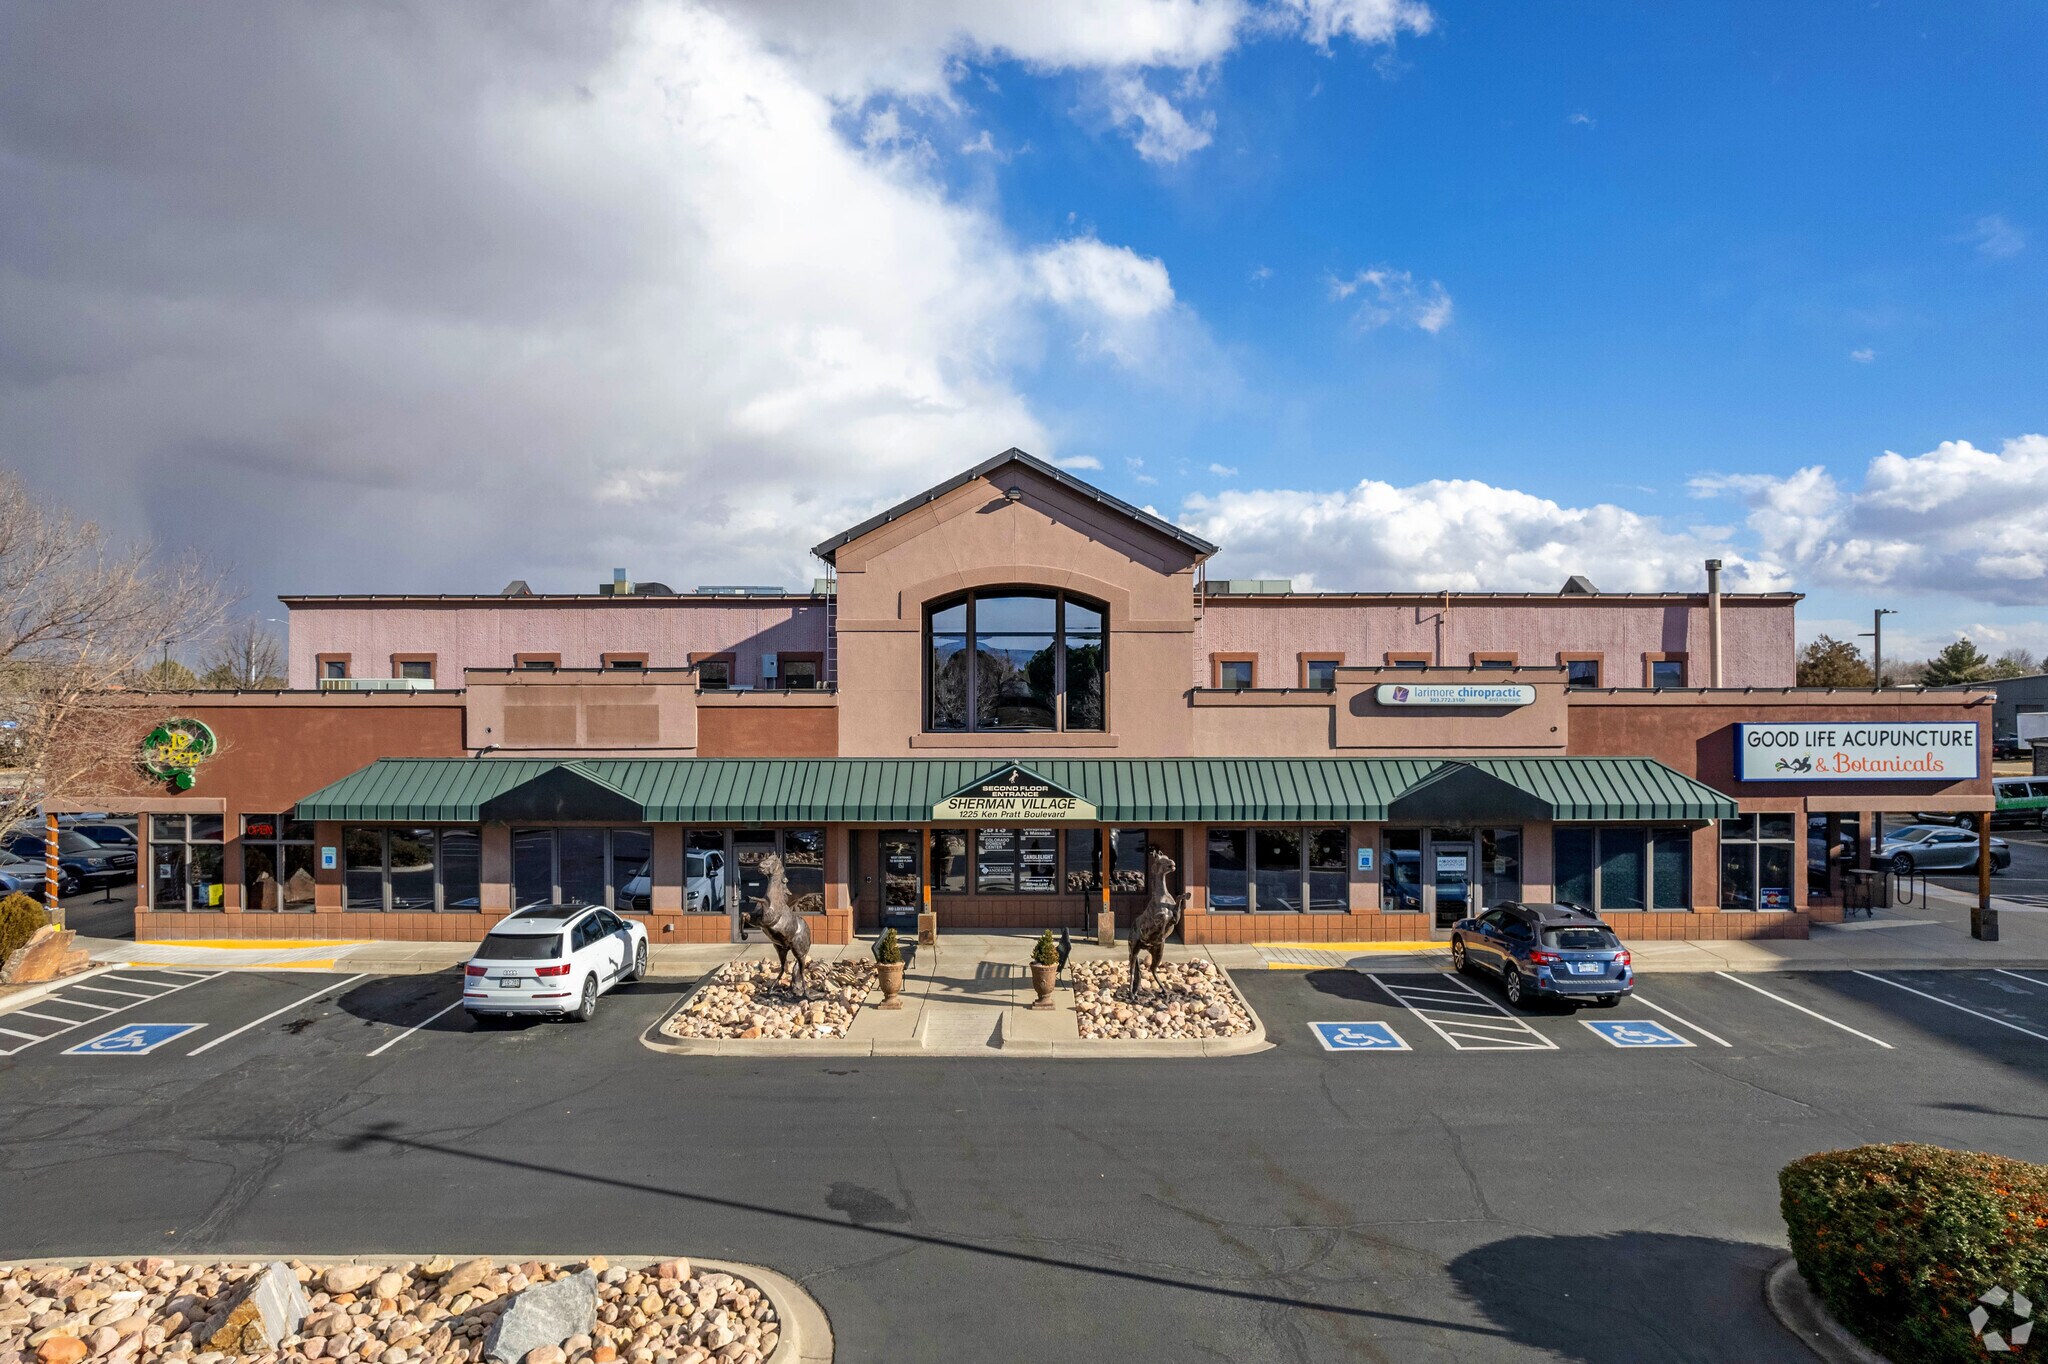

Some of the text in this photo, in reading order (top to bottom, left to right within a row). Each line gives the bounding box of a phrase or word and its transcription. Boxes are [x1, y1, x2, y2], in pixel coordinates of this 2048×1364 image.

[1415, 687, 1521, 699] larimore chiropractic
[1747, 730, 1973, 747] GOOD LIFE ACUPUNCTURE
[1815, 752, 1944, 773] & Botanicals
[948, 799, 1076, 810] SHERMAN VILLAGE
[247, 824, 273, 835] OPEN
